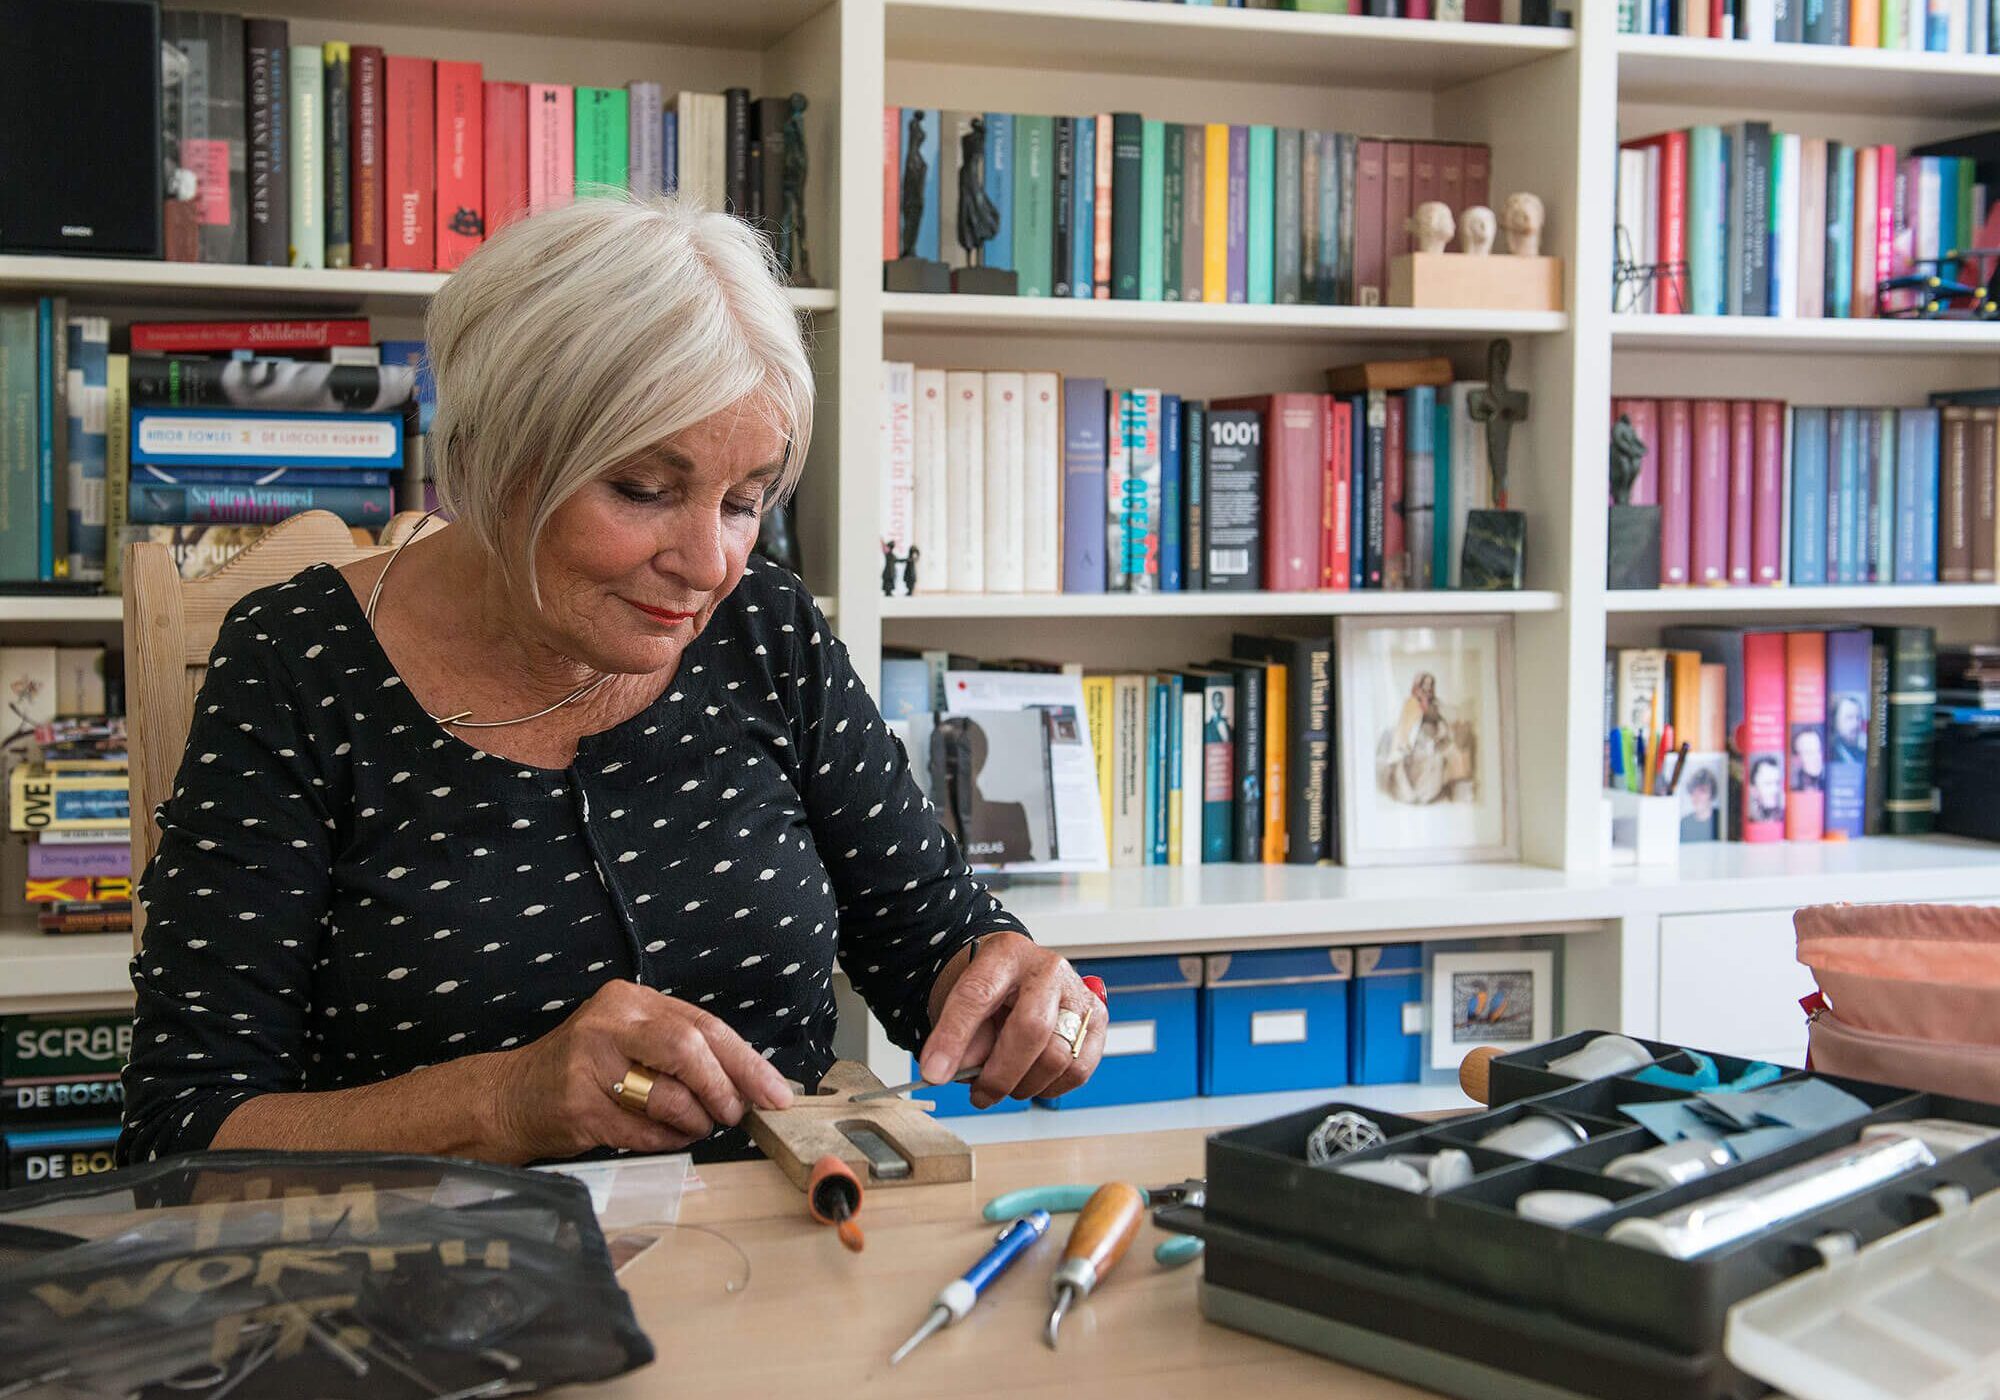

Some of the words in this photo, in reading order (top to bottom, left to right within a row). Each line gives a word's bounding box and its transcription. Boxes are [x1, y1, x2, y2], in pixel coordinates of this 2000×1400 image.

[252, 48, 268, 105] JACOB
[253, 109, 268, 146] VAN
[254, 151, 268, 223] LENNEP
[402, 191, 422, 245] Tonio
[262, 431, 275, 443] DE
[893, 402, 909, 453] Made
[1210, 421, 1260, 446] 1001
[893, 461, 909, 479] in
[191, 485, 240, 506] Sandro
[243, 487, 314, 506] Veronesi
[1311, 651, 1330, 679] Bart
[1311, 741, 1328, 759] De
[17, 1085, 51, 1108] DE
[27, 1154, 66, 1180] DE
